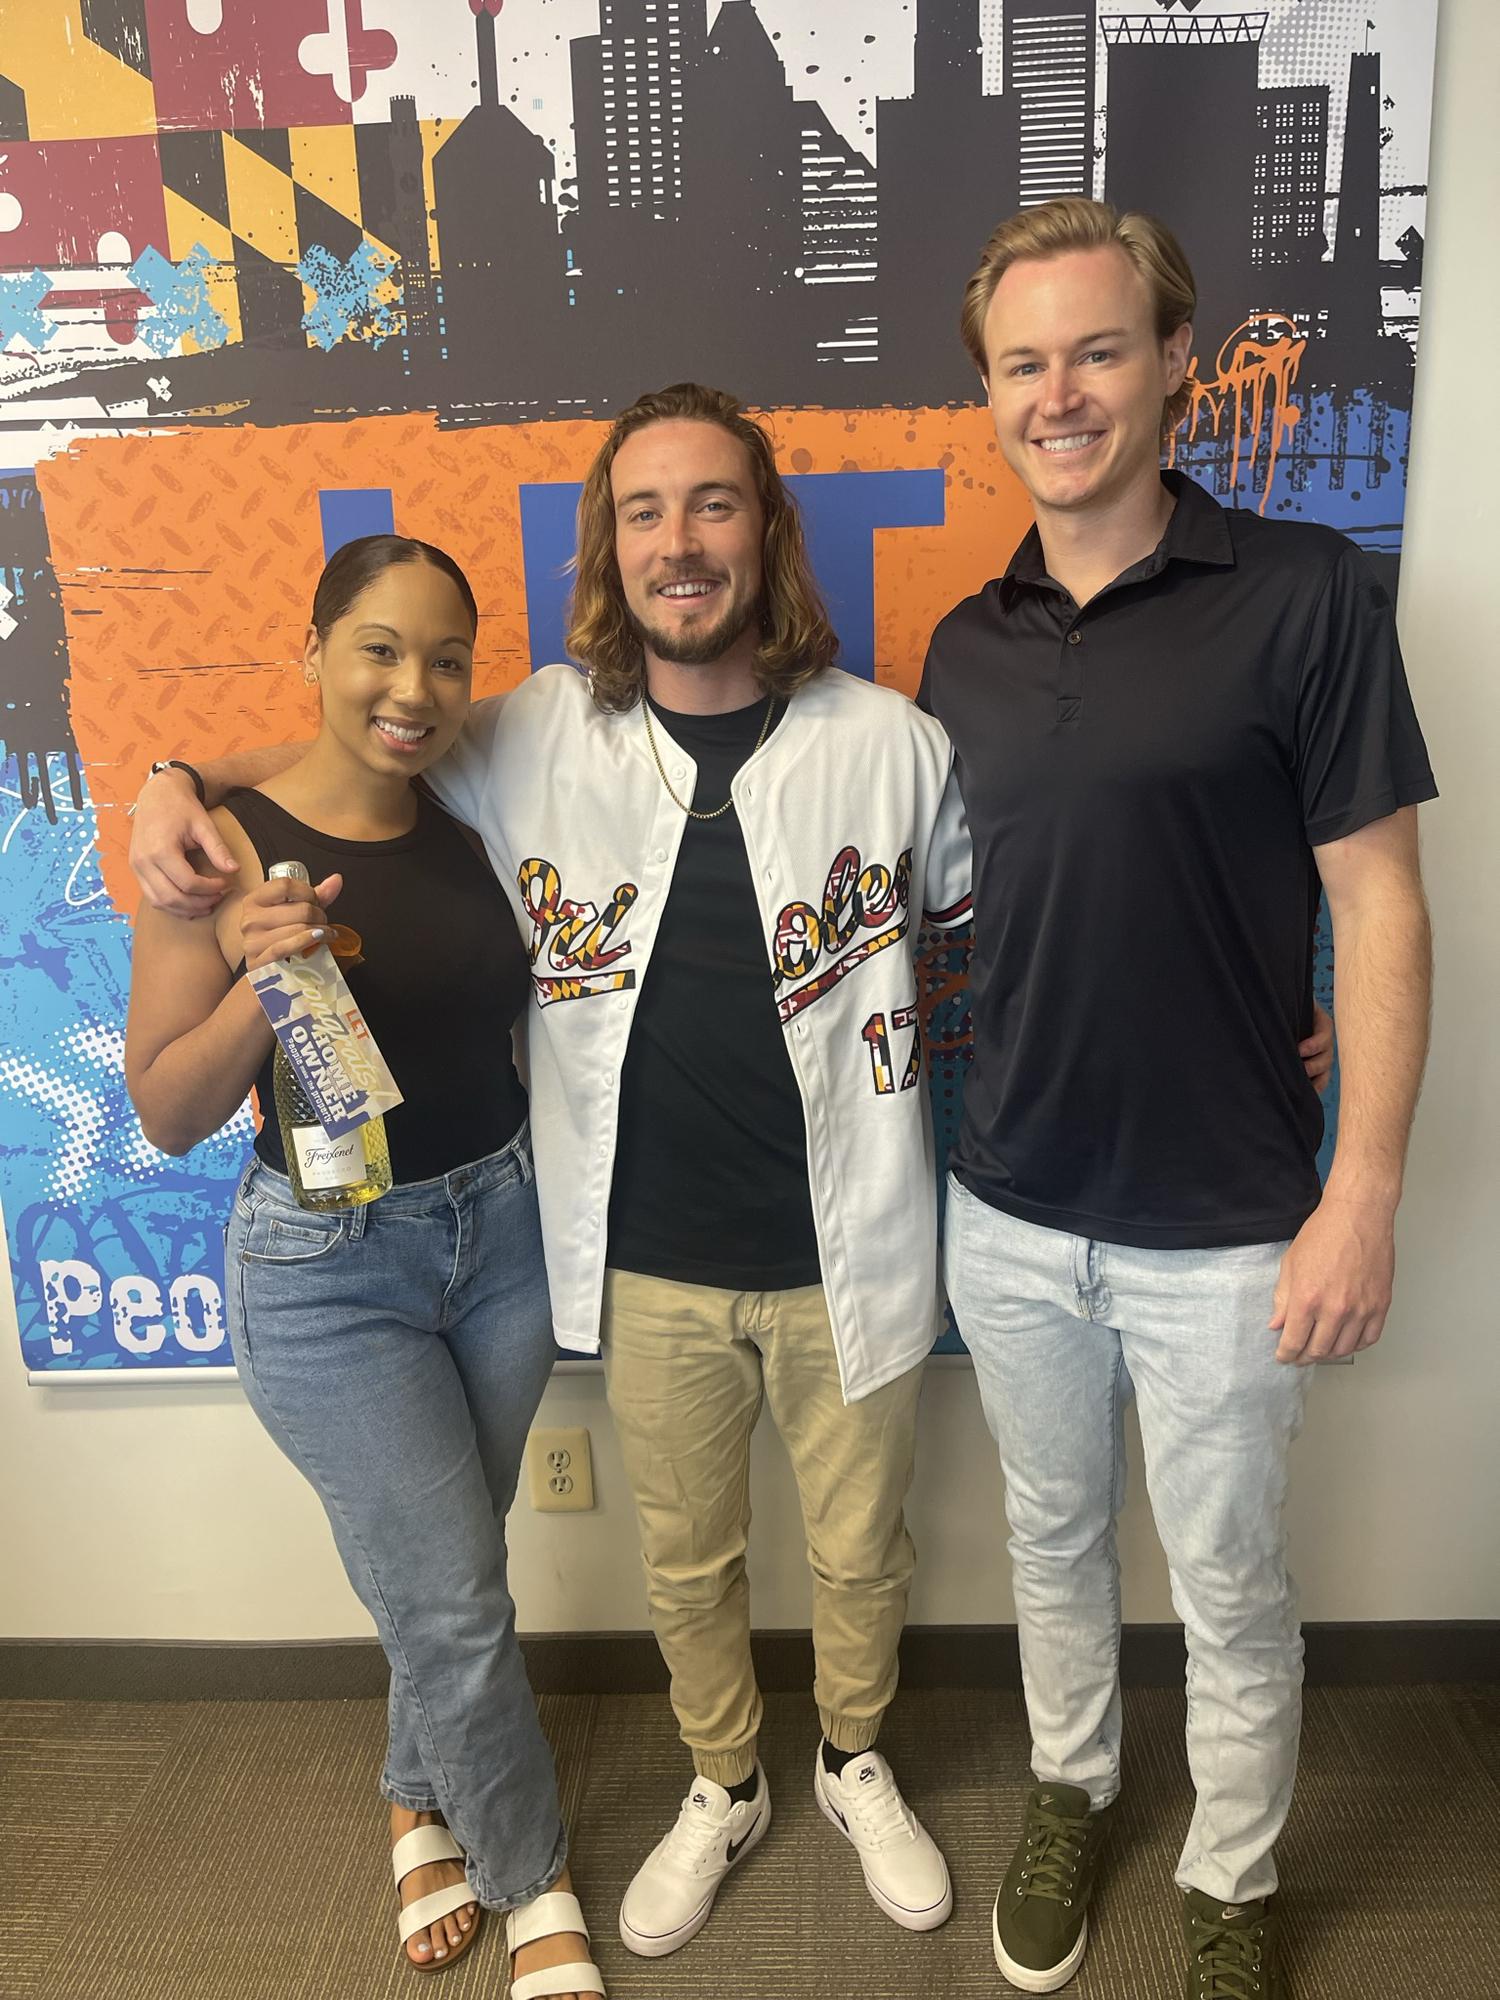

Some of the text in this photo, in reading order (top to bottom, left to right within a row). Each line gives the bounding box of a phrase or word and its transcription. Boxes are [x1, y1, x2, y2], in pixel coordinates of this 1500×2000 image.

[286, 1038, 303, 1065] People
[290, 965, 399, 1098] Congrats!
[345, 1008, 370, 1040] LET
[861, 1002, 919, 1094] 17
[291, 1025, 348, 1122] OWNER
[311, 1031, 359, 1103] HOME
[304, 1144, 355, 1168] Freixenet
